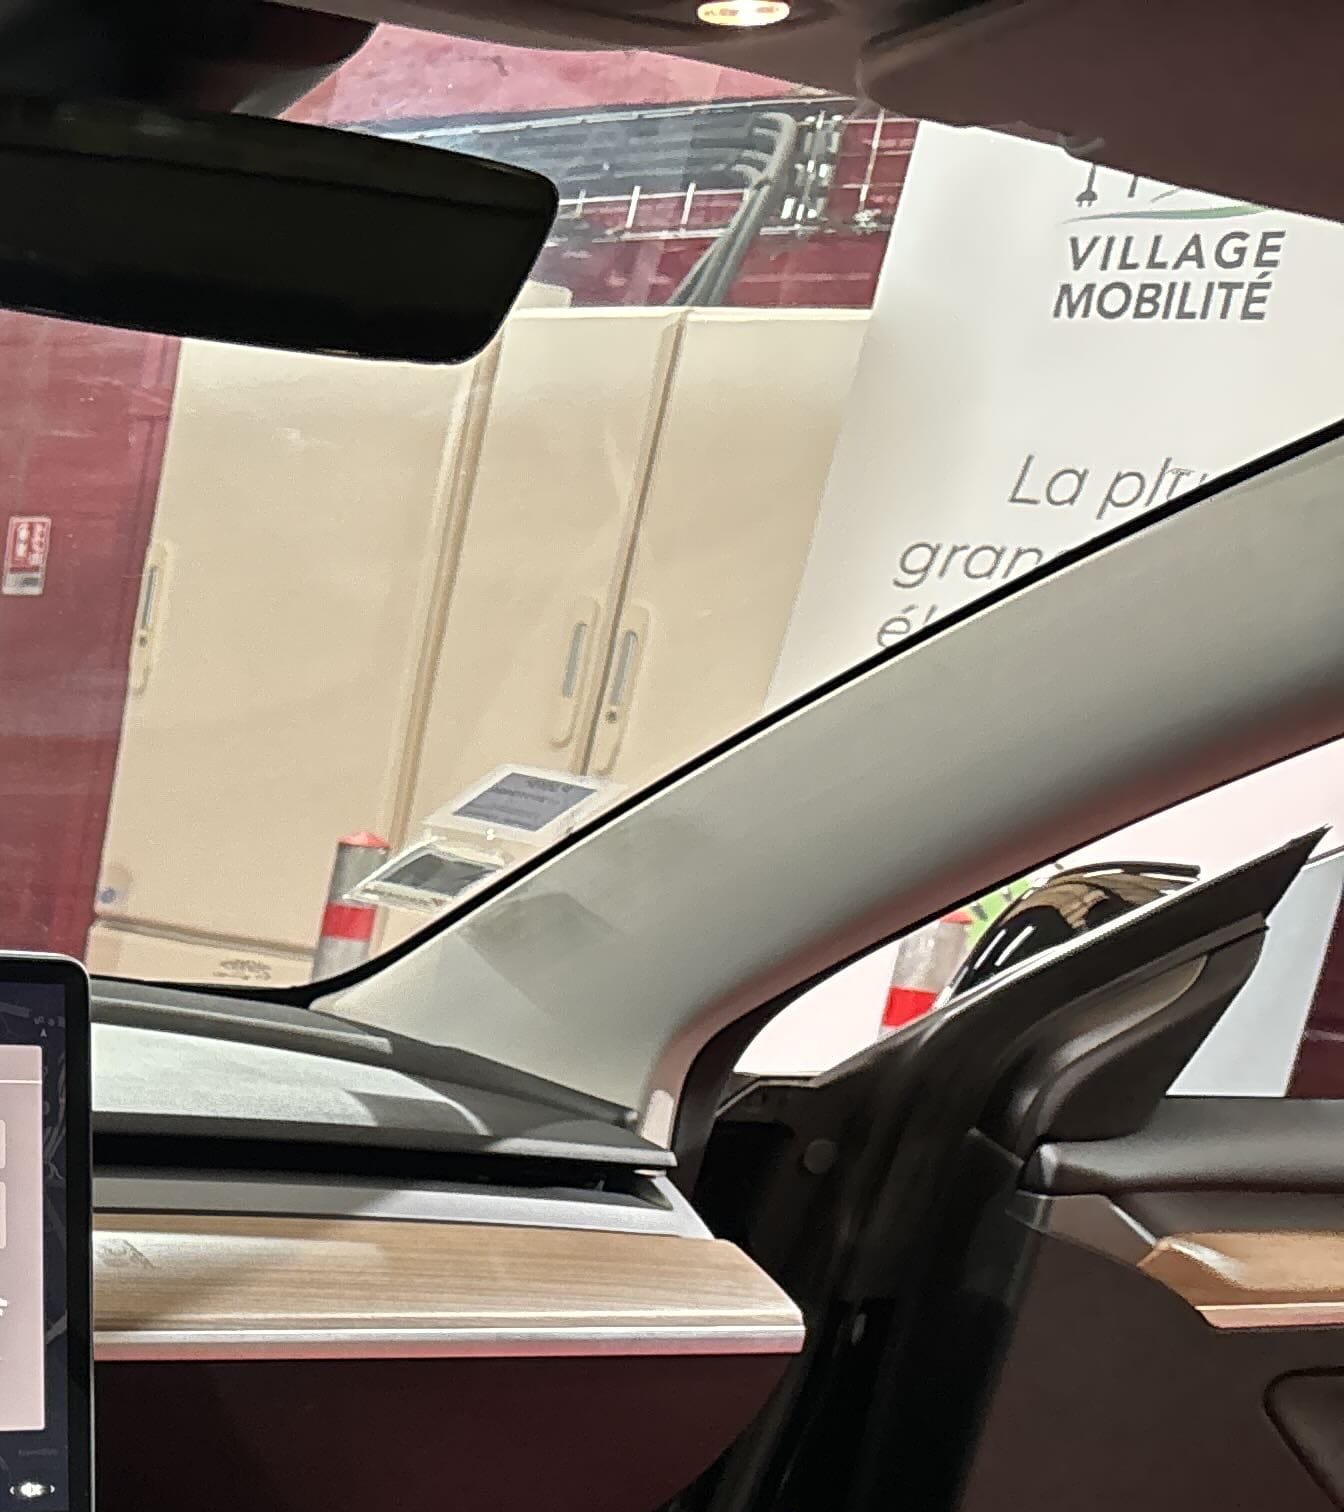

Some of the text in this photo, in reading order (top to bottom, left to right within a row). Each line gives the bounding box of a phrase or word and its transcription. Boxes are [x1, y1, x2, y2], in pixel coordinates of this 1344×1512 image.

[1068, 230, 1286, 272] VILLAGE
[1053, 272, 1272, 321] MOBILITÉ
[1008, 454, 1208, 521] La pl
[892, 542, 1044, 589] gran
